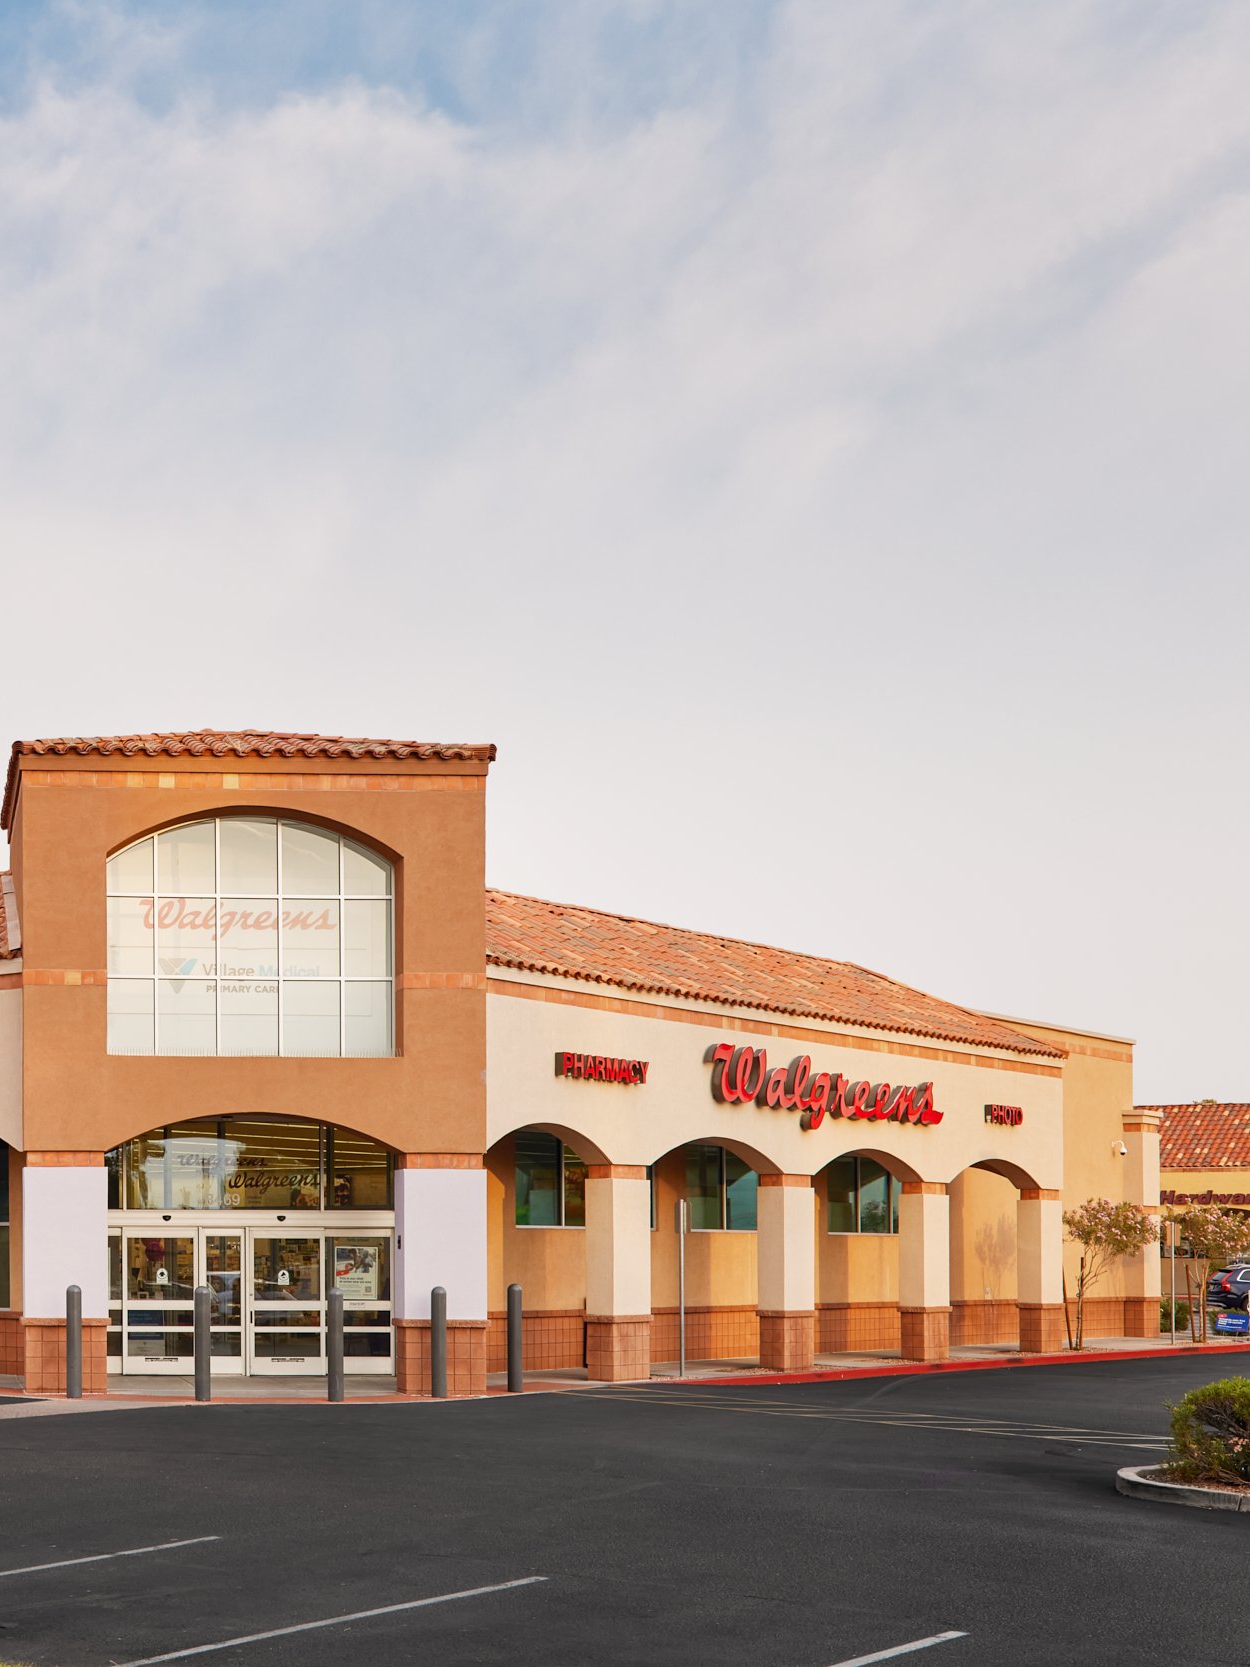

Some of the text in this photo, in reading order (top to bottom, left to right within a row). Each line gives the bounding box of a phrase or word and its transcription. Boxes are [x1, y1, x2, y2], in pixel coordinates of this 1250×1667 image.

[139, 898, 337, 941] Walgreens
[562, 1052, 650, 1086] PHARMACY
[712, 1043, 944, 1130] Walgreens
[991, 1103, 1024, 1126] PHOTO
[228, 1172, 321, 1195] Walgreens
